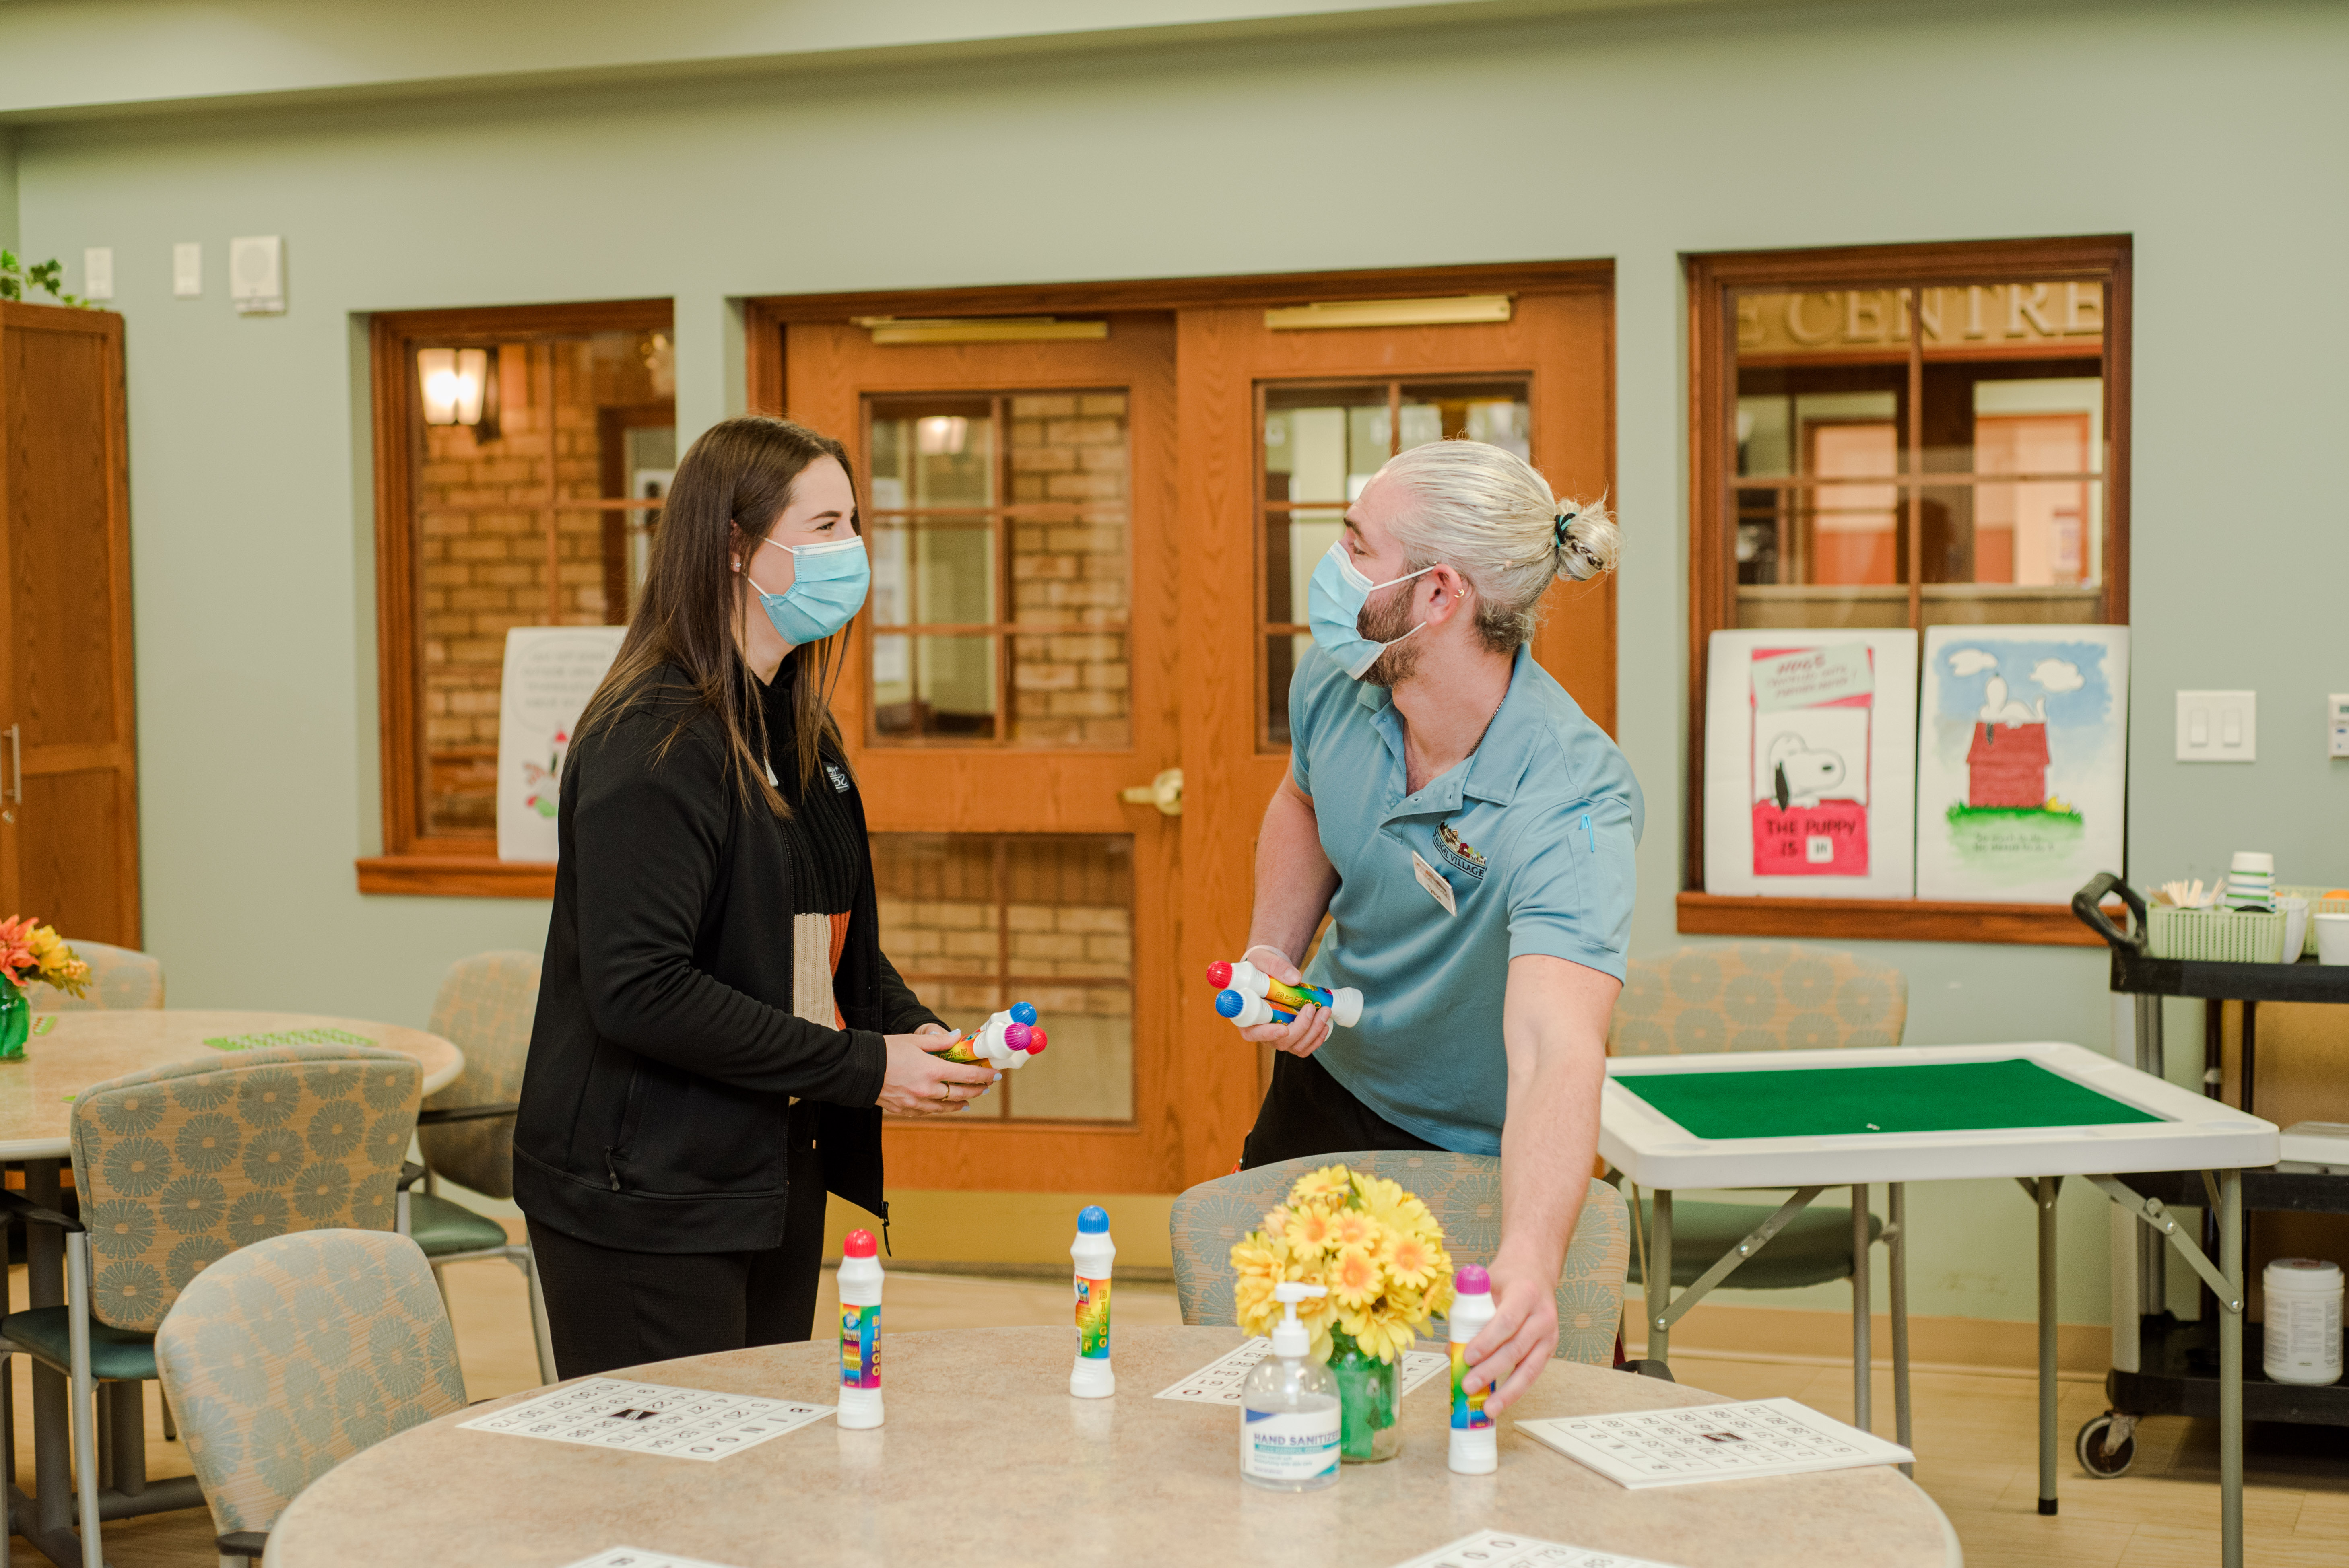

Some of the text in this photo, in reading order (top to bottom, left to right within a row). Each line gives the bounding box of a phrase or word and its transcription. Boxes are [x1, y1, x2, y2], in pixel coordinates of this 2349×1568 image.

[1786, 282, 2103, 345] CENTRE
[1767, 819, 1856, 835] THE PUPPY
[1782, 842, 1828, 856] IS IN
[1450, 853, 1487, 877] VILLAGE
[1275, 992, 1322, 1009] BINGO
[1099, 1290, 1107, 1348] BINGO
[872, 1315, 880, 1376] BINGO
[547, 1401, 572, 1409] 37
[518, 1410, 546, 1418] 50
[583, 1406, 610, 1414] 34
[687, 1405, 711, 1415] 27
[723, 1410, 750, 1418] 20
[490, 1420, 520, 1428] 73
[658, 1416, 683, 1424] 43
[529, 1424, 557, 1432] 69
[633, 1425, 661, 1433] 54
[567, 1429, 595, 1437] 68
[671, 1430, 700, 1438] 52
[606, 1435, 636, 1443] 70
[1254, 1433, 1286, 1446] HAND
[647, 1439, 674, 1448] 64
